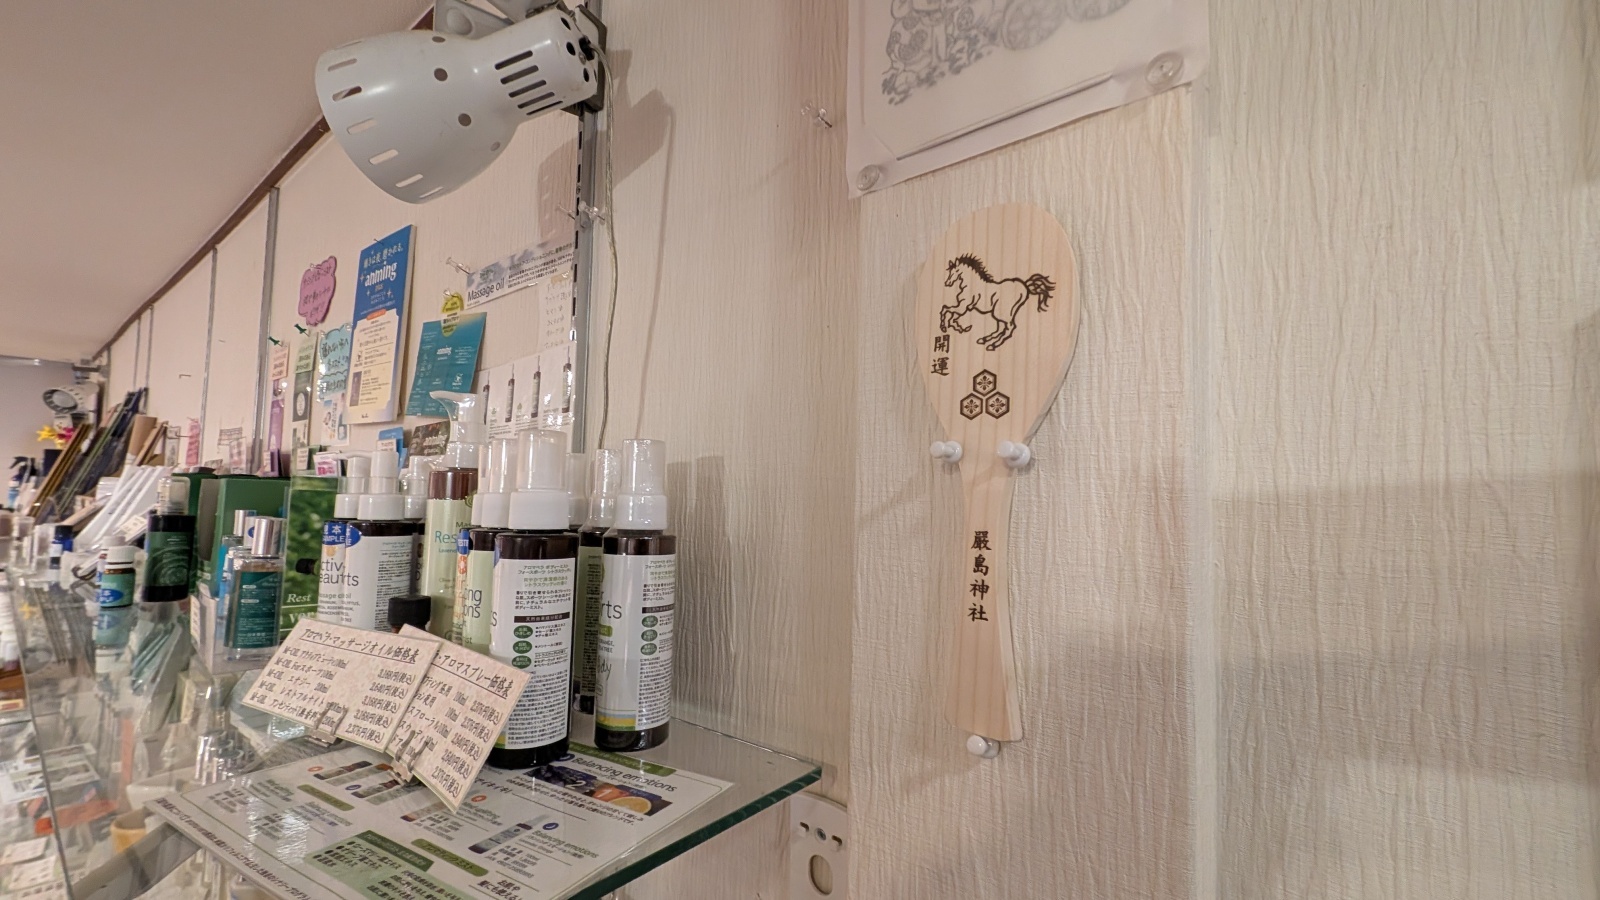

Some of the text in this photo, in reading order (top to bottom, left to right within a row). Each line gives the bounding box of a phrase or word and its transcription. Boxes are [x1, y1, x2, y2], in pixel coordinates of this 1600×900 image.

[364, 261, 398, 287] anming
[467, 277, 505, 302] Massage oil
[930, 334, 951, 377] 開運
[286, 593, 312, 603] Rest
[571, 757, 622, 777] Balancing
